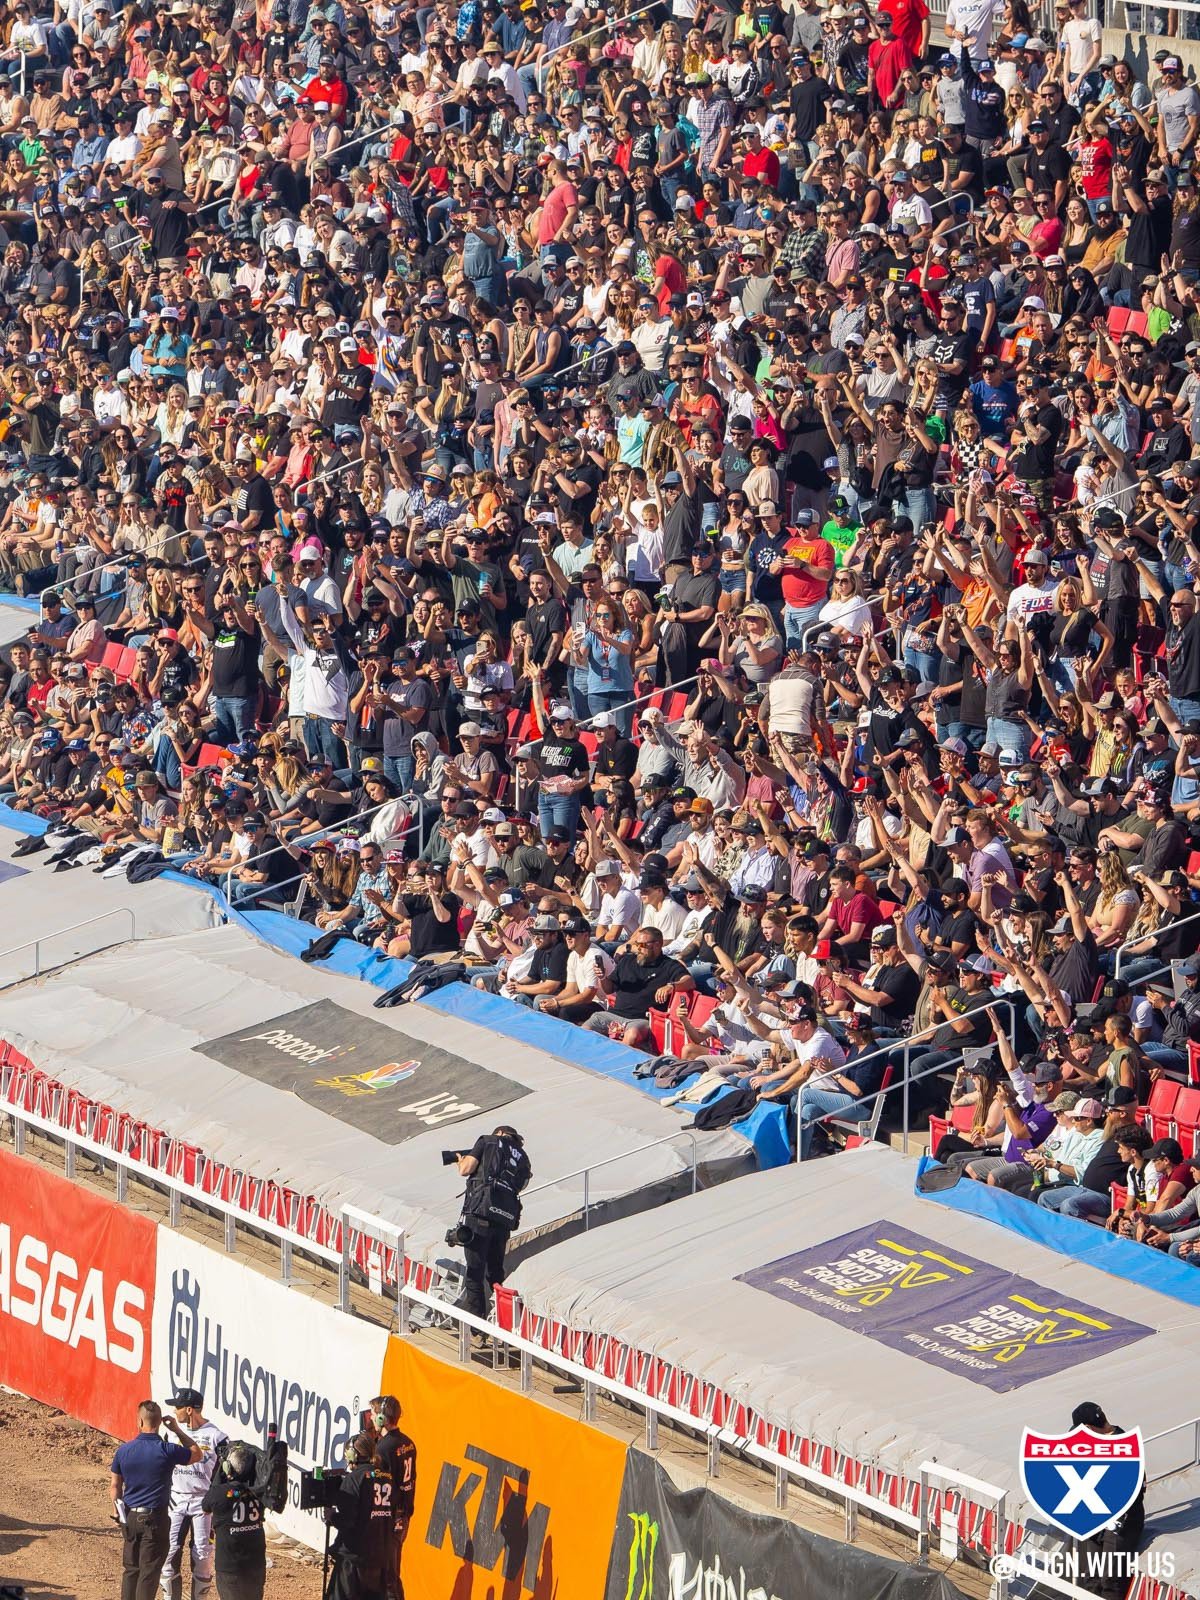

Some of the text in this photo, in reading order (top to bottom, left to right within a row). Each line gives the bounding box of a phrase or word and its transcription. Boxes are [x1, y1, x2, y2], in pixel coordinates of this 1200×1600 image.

[1025, 598, 1046, 608] FOX
[240, 1029, 341, 1064] peacock
[828, 1259, 884, 1283] MOTO
[848, 1248, 907, 1275] SUPER
[803, 1266, 863, 1290] CROSS
[960, 1317, 1017, 1340] MOTO
[979, 1305, 1042, 1332] SUPER
[933, 1324, 994, 1347] CROSS
[201, 1317, 351, 1470] Husqvarna
[373, 1483, 392, 1506] 32
[371, 1510, 392, 1521] peacock
[425, 1443, 551, 1593] KTM
[230, 1523, 260, 1535] peacock
